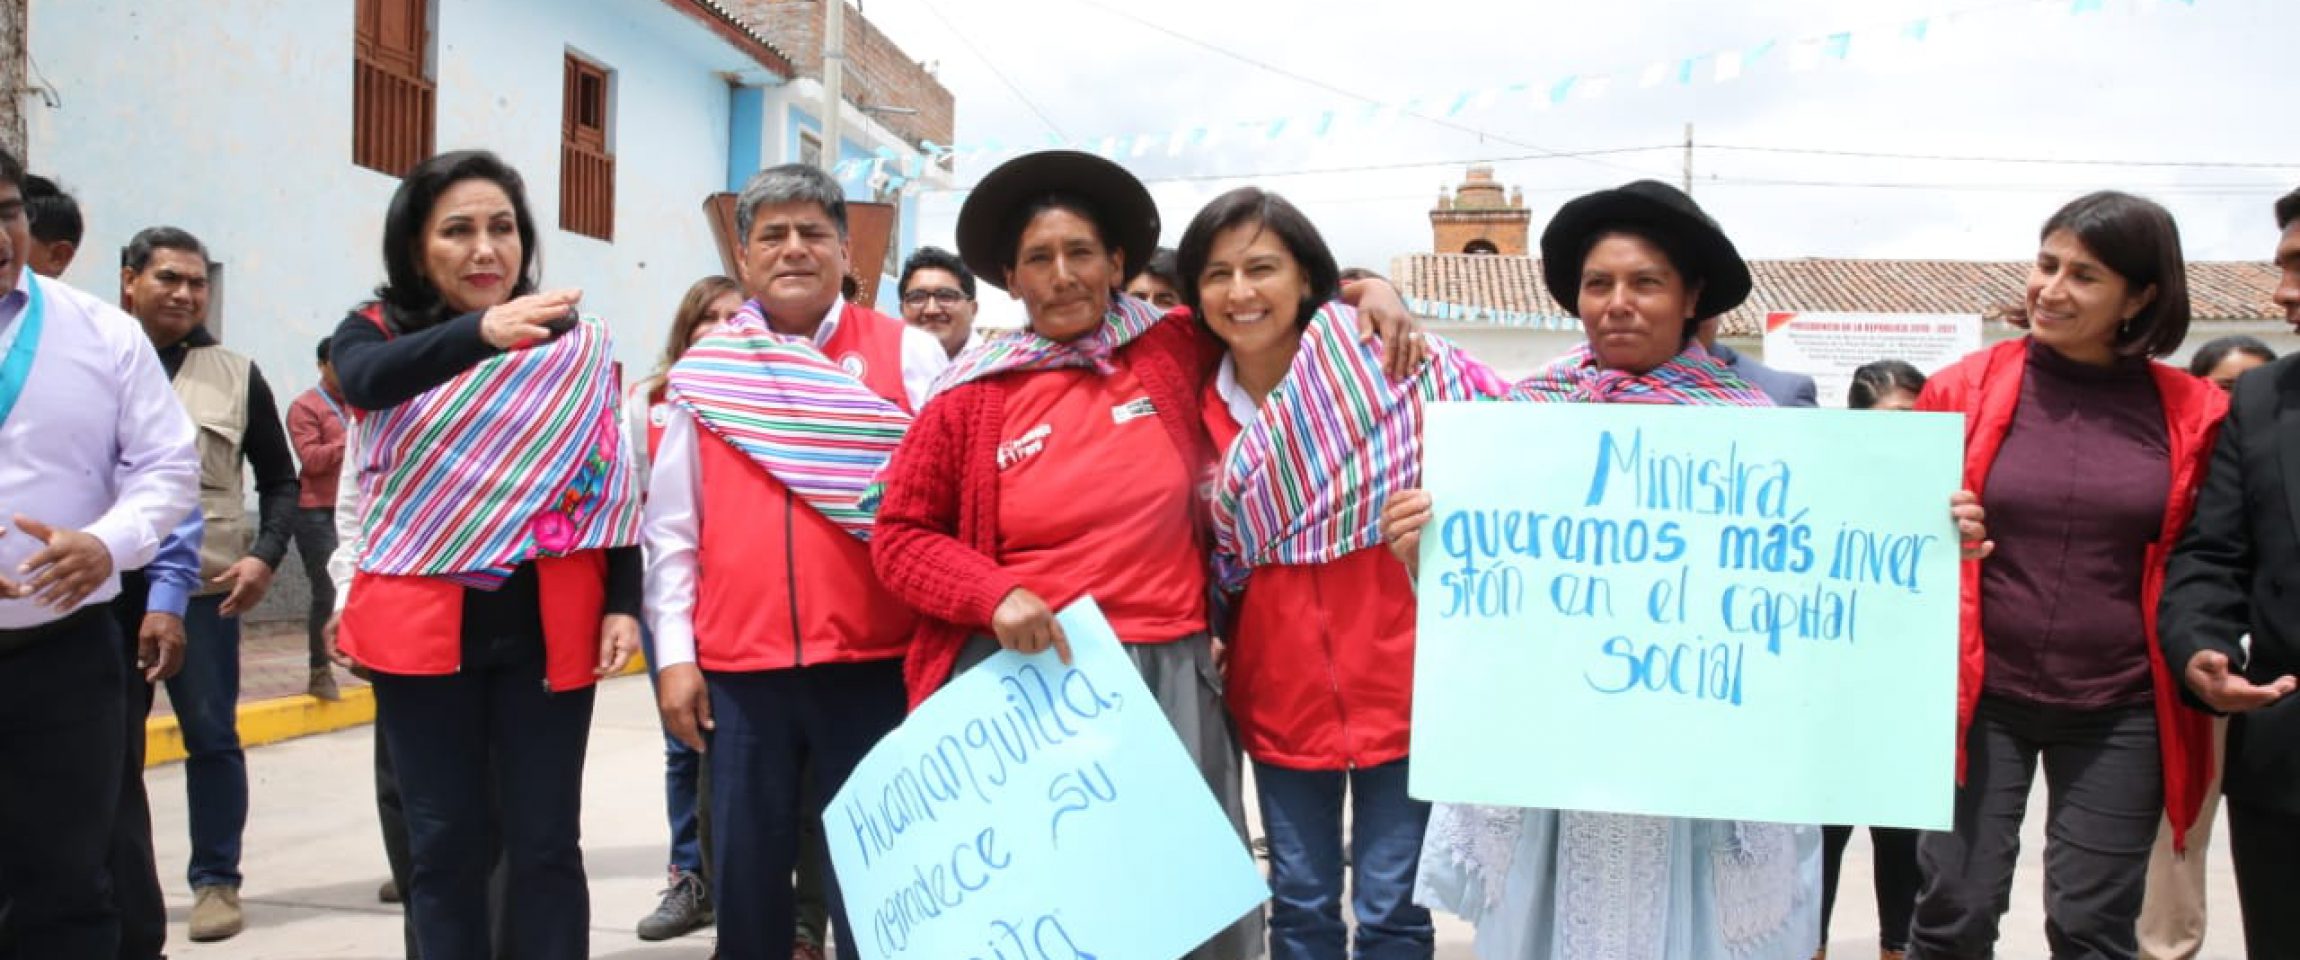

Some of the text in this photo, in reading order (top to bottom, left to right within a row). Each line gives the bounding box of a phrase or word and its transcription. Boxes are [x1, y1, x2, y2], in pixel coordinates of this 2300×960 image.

[1585, 428, 1791, 518] Ministra
[1441, 510, 1687, 592] queremos
[1719, 507, 1815, 574] más
[1551, 573, 1615, 617] en
[1648, 565, 1688, 623] el
[875, 827, 1011, 958] agradece
